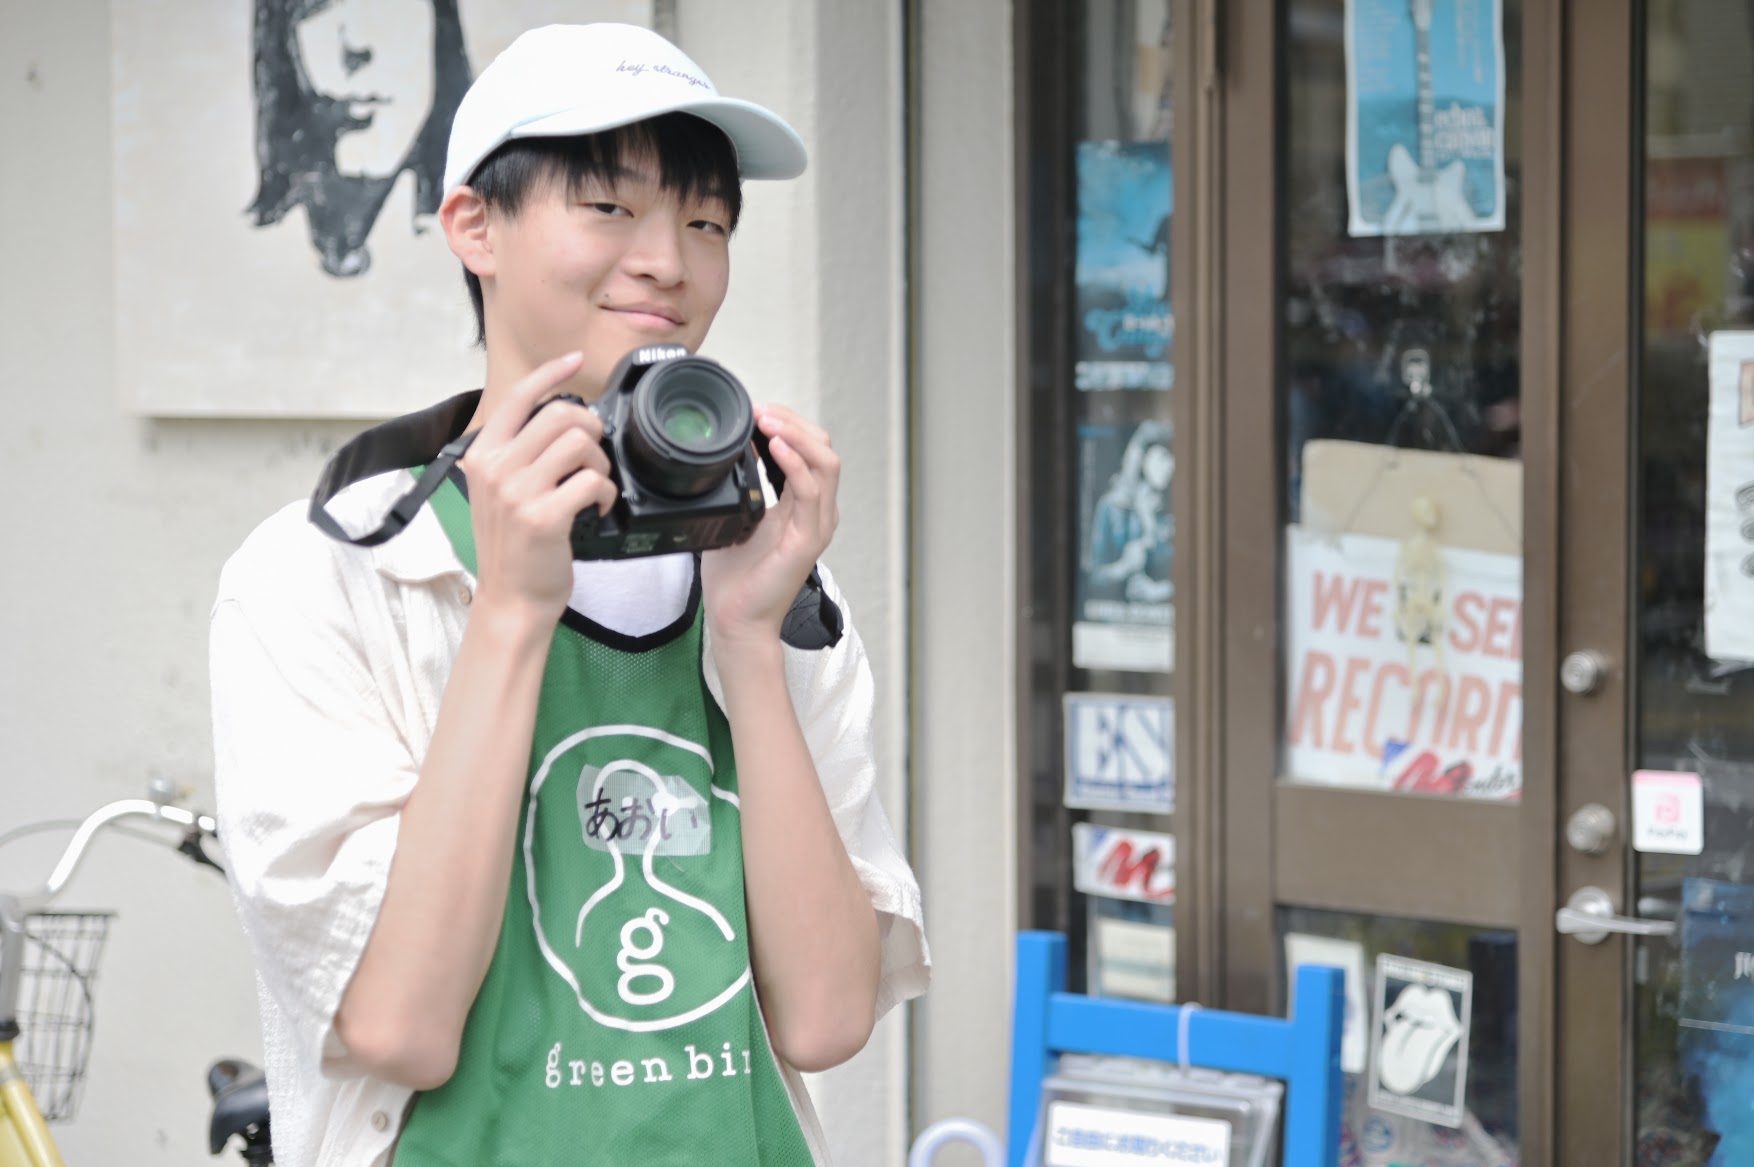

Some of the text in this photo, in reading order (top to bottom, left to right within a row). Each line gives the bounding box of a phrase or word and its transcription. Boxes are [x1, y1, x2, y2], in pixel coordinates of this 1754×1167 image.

[616, 60, 649, 76] hey
[639, 346, 687, 363] Nikon
[1312, 570, 1390, 638] WE
[585, 787, 698, 842] あおい
[616, 907, 675, 1006] g
[545, 1042, 672, 1088] green
